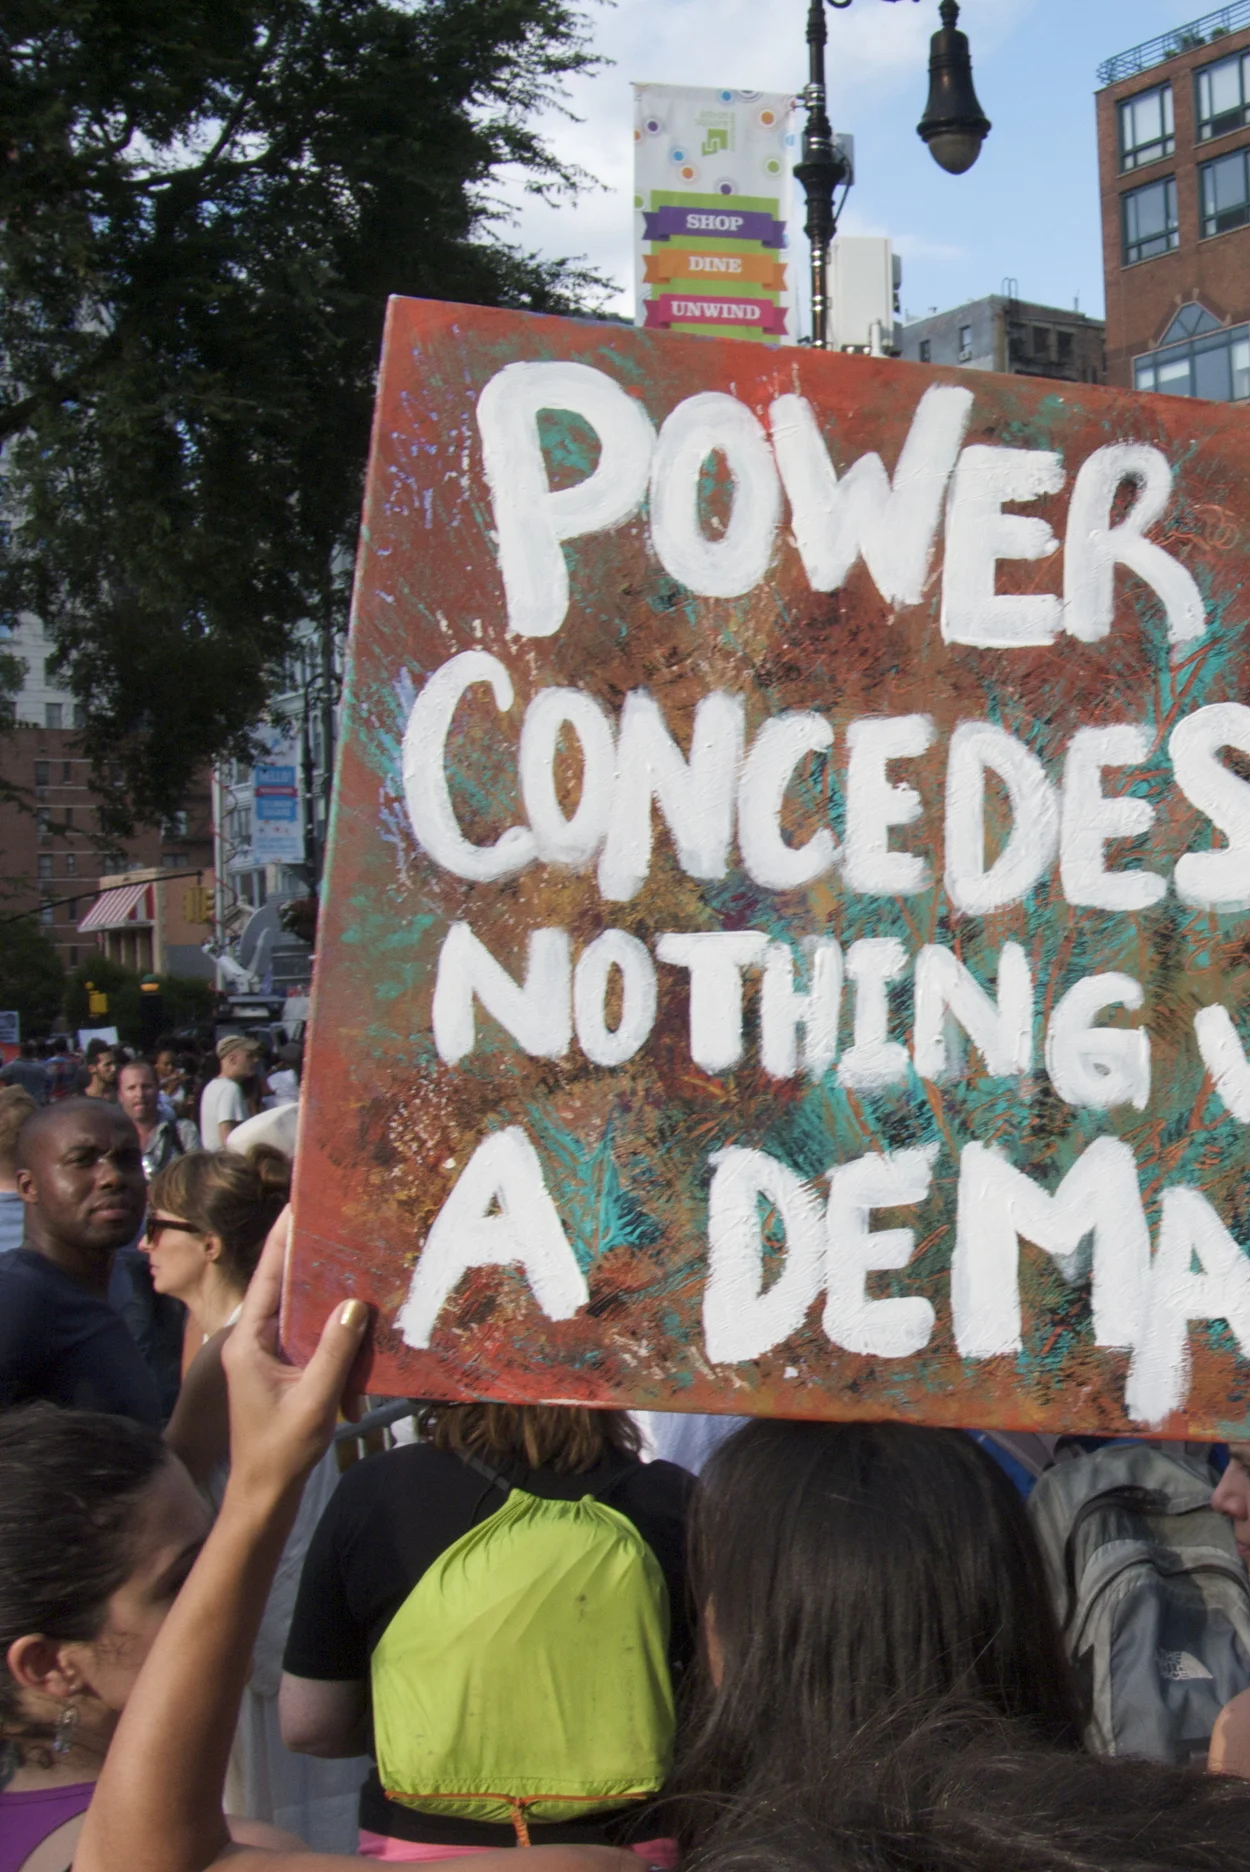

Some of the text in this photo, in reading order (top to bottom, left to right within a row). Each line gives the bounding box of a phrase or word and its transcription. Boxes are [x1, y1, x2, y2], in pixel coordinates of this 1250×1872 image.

[686, 214, 743, 231] SHOP
[688, 255, 742, 273] DINE
[670, 301, 761, 320] UNWIND
[476, 361, 1206, 648] POWER
[432, 921, 1151, 1111] NOTHING
[393, 1125, 590, 1349] A
